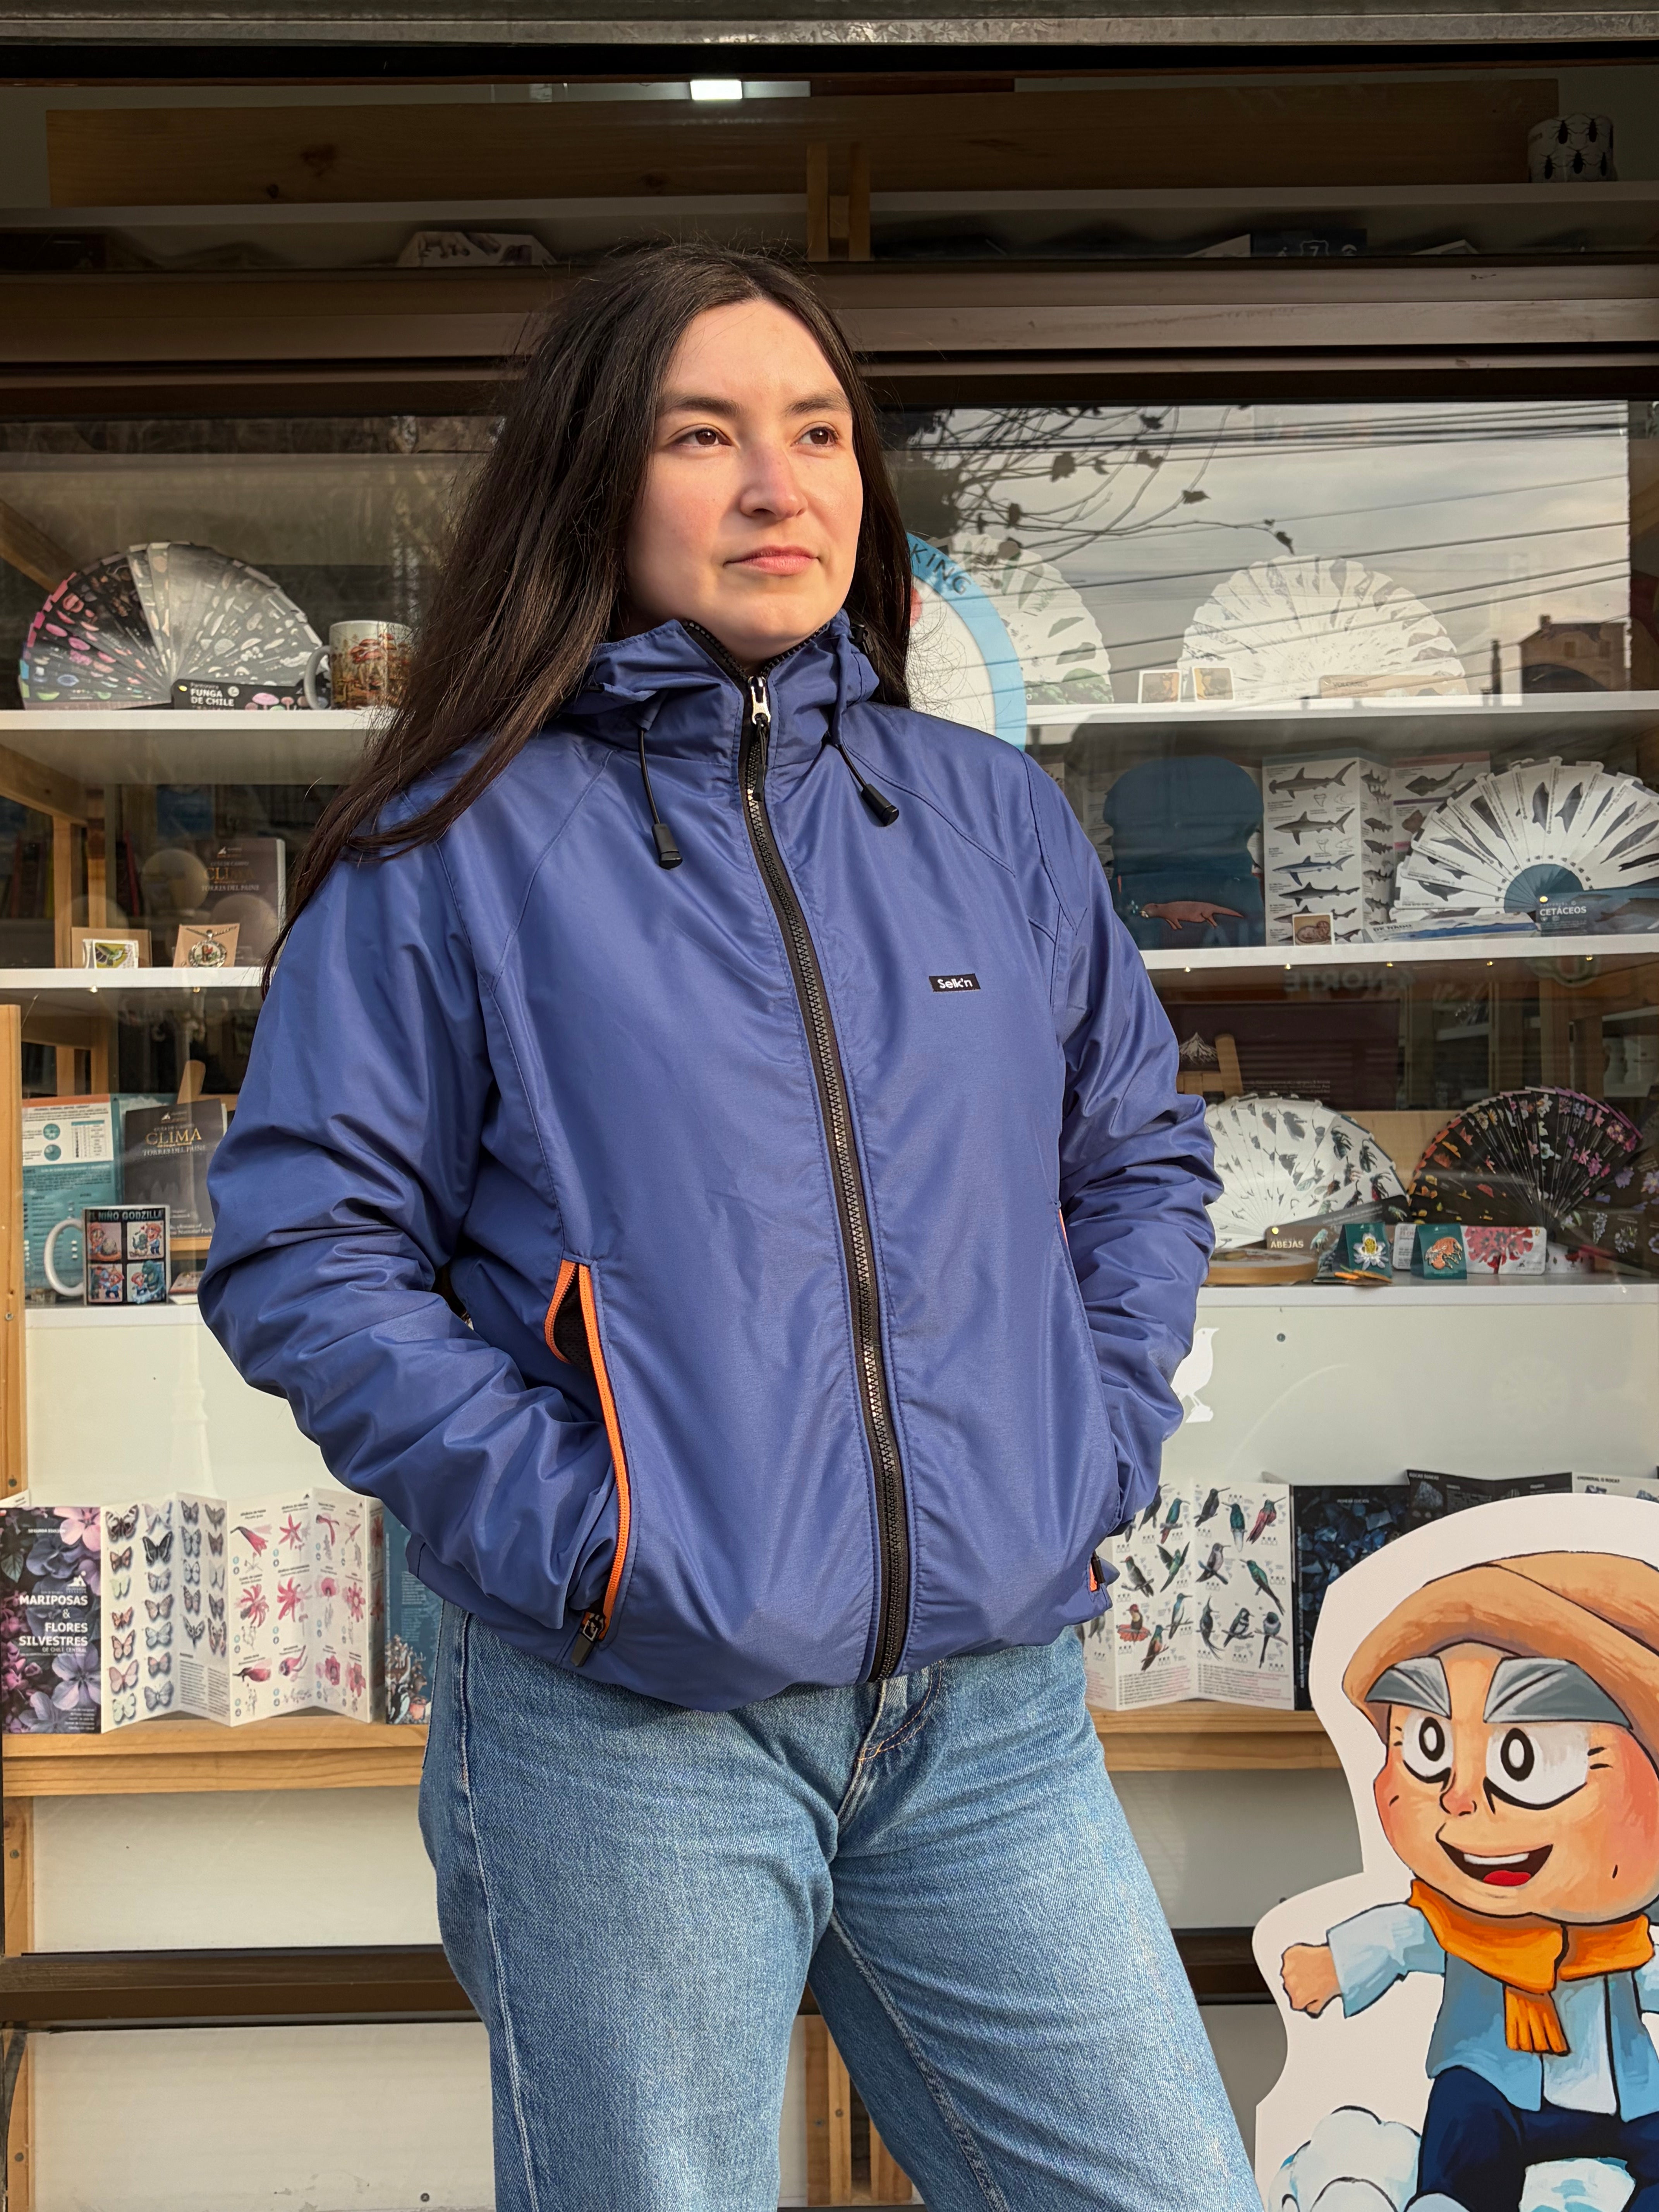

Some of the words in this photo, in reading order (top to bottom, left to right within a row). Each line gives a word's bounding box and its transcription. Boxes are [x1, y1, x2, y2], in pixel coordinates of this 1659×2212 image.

[191, 688, 223, 697] FUNGA
[191, 696, 204, 704] DE
[206, 697, 235, 707] CHILE
[1539, 905, 1587, 916] CETÁCEOS
[937, 977, 973, 989] Selk'n
[145, 1127, 203, 1145] CLIMA
[122, 1209, 163, 1220] GODZILLA
[1270, 1240, 1304, 1249] ABEJAS
[19, 1595, 88, 1606] MARIPOSAS
[62, 1608, 71, 1619] &
[45, 1622, 88, 1633] FLORES
[19, 1635, 88, 1646] SILVESTRES
